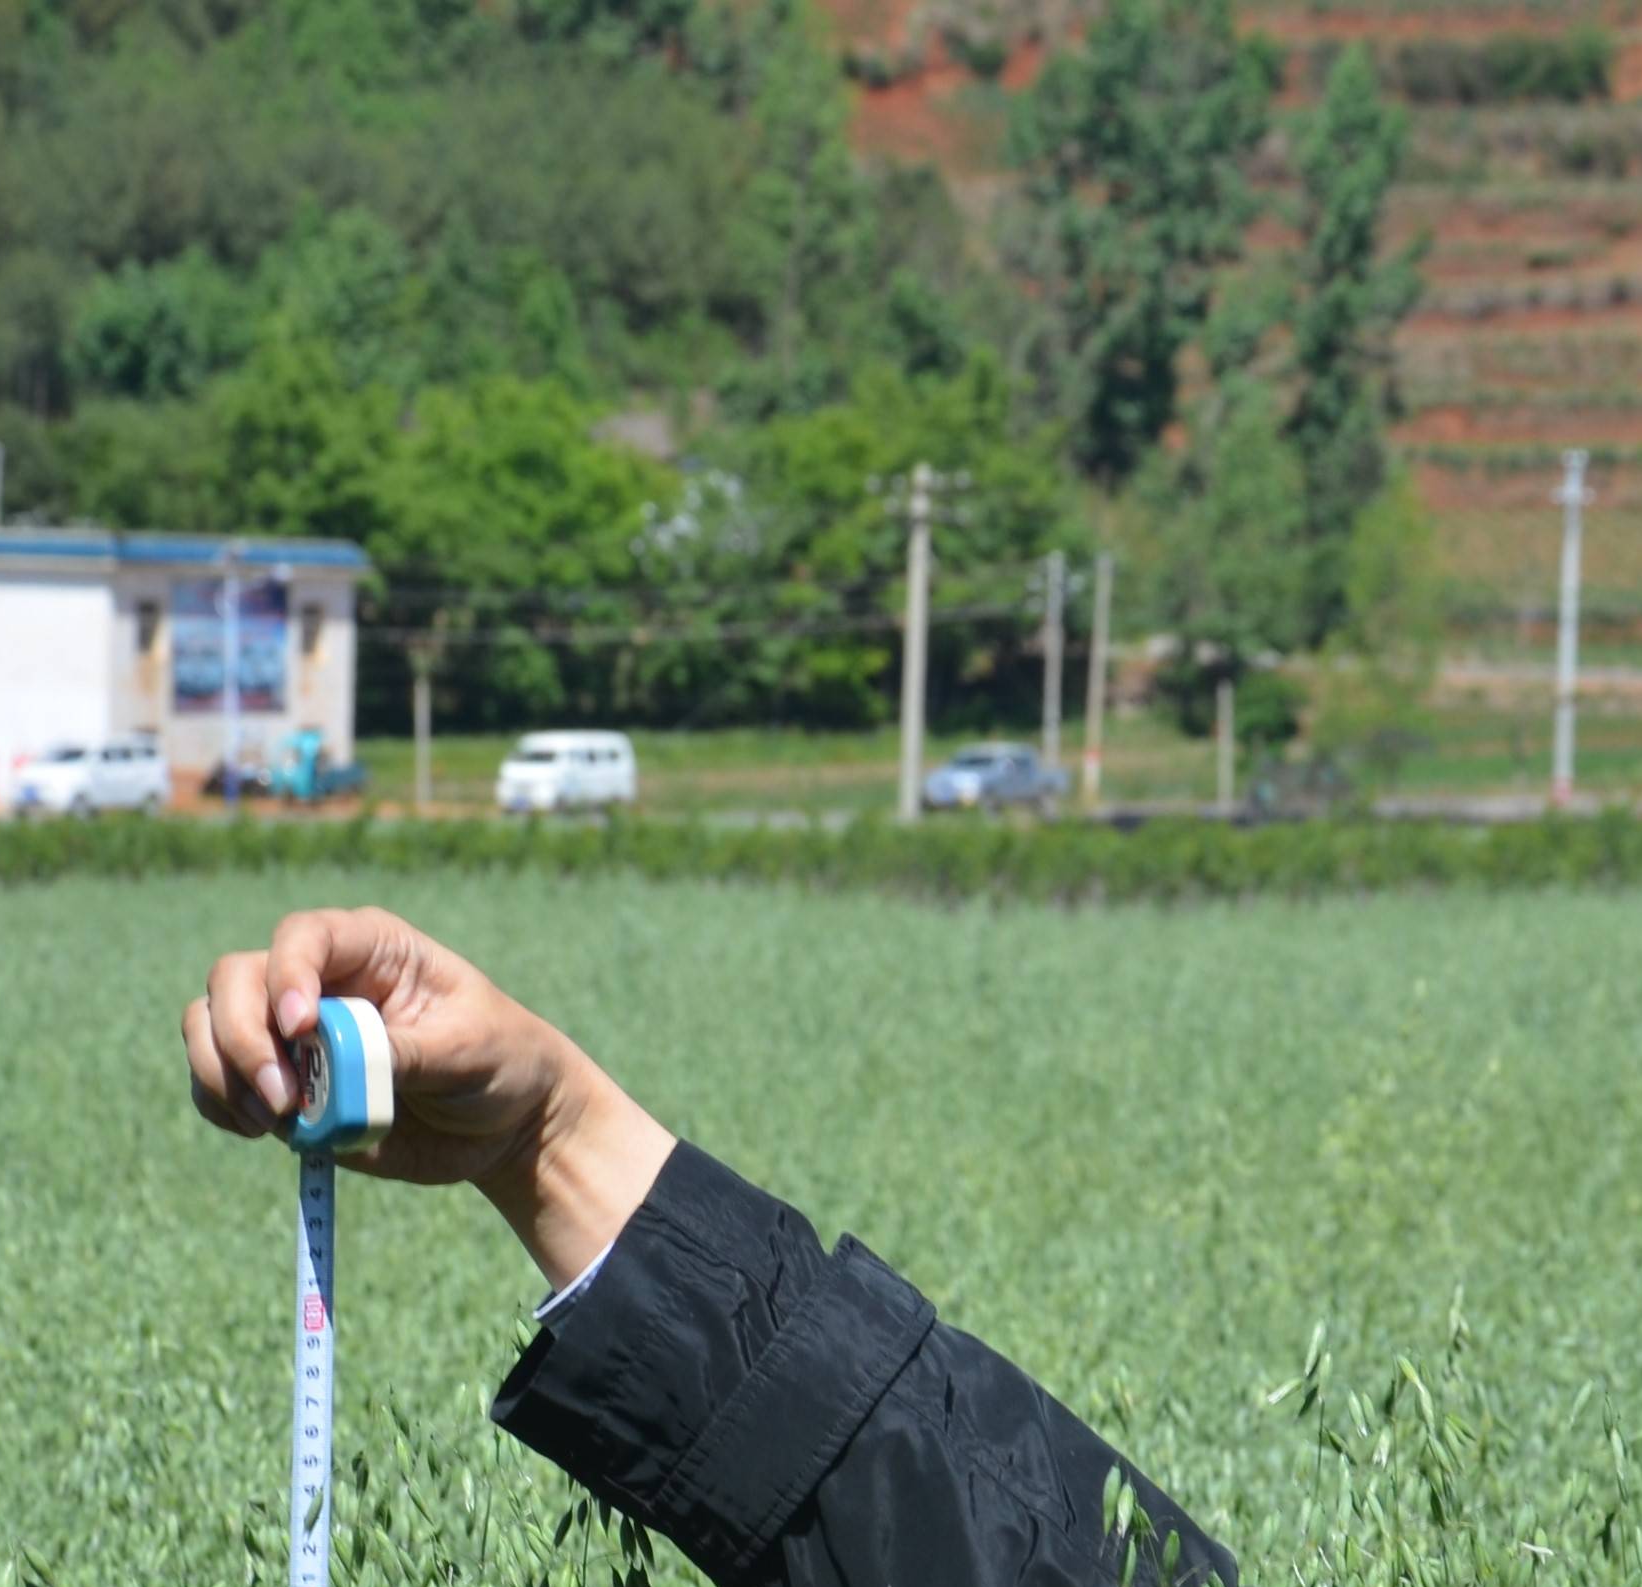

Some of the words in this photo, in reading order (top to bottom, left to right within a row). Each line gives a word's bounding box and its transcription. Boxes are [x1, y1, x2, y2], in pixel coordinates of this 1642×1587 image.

[309, 1156, 324, 1171] 5
[309, 1186, 323, 1201] 4
[309, 1216, 323, 1231] 3
[309, 1246, 323, 1261] 2
[306, 1334, 321, 1350] 9
[306, 1364, 320, 1380] 8
[305, 1395, 319, 1410] 7
[304, 1424, 319, 1440] 6
[304, 1454, 318, 1469] 5
[302, 1543, 317, 1557] 2
